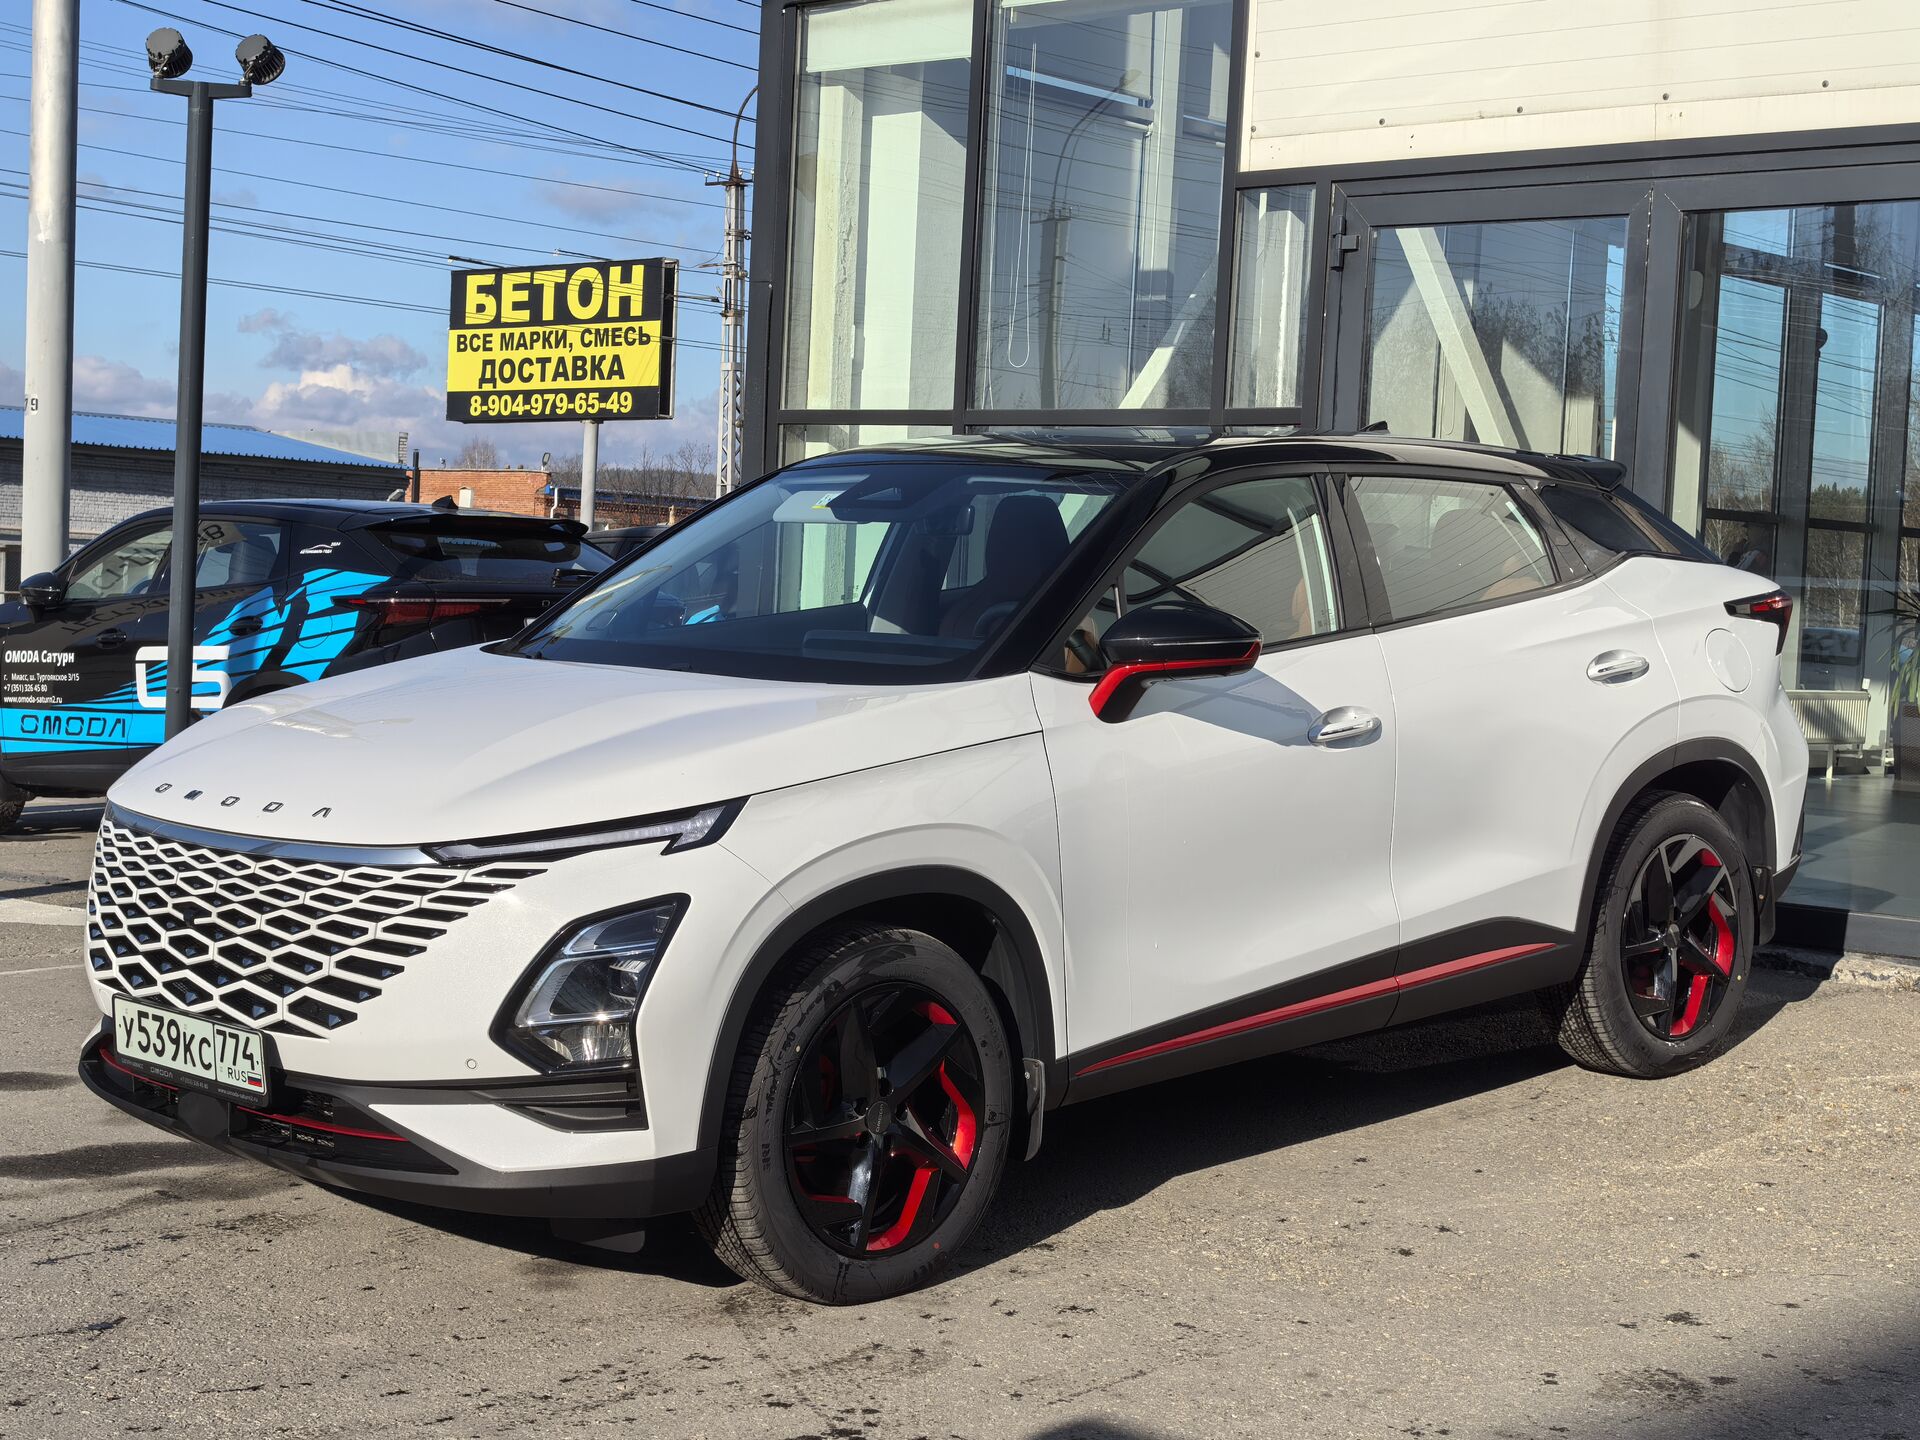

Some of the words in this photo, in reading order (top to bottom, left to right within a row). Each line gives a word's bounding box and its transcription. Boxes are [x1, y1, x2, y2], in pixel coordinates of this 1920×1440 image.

[465, 265, 645, 324] БЕТОН
[456, 333, 493, 352] ВСЕ
[500, 329, 573, 352] МАРКИ,
[580, 326, 650, 348] СМЕСЬ
[478, 354, 625, 389] ДОСТАВКА
[469, 391, 632, 416] 8-904-979-65-49
[5, 650, 39, 663] OMODA
[41, 650, 75, 666] Сатурн
[4, 684, 10, 692] +7
[11, 684, 24, 693] (351)
[24, 684, 33, 692] 326
[34, 684, 40, 692] 45
[41, 684, 47, 692] 80
[68, 673, 80, 682] 3/15
[21, 715, 126, 738] OMODA
[155, 782, 333, 818] OMODA
[215, 1028, 256, 1071] 774
[228, 1066, 247, 1082] RUS
